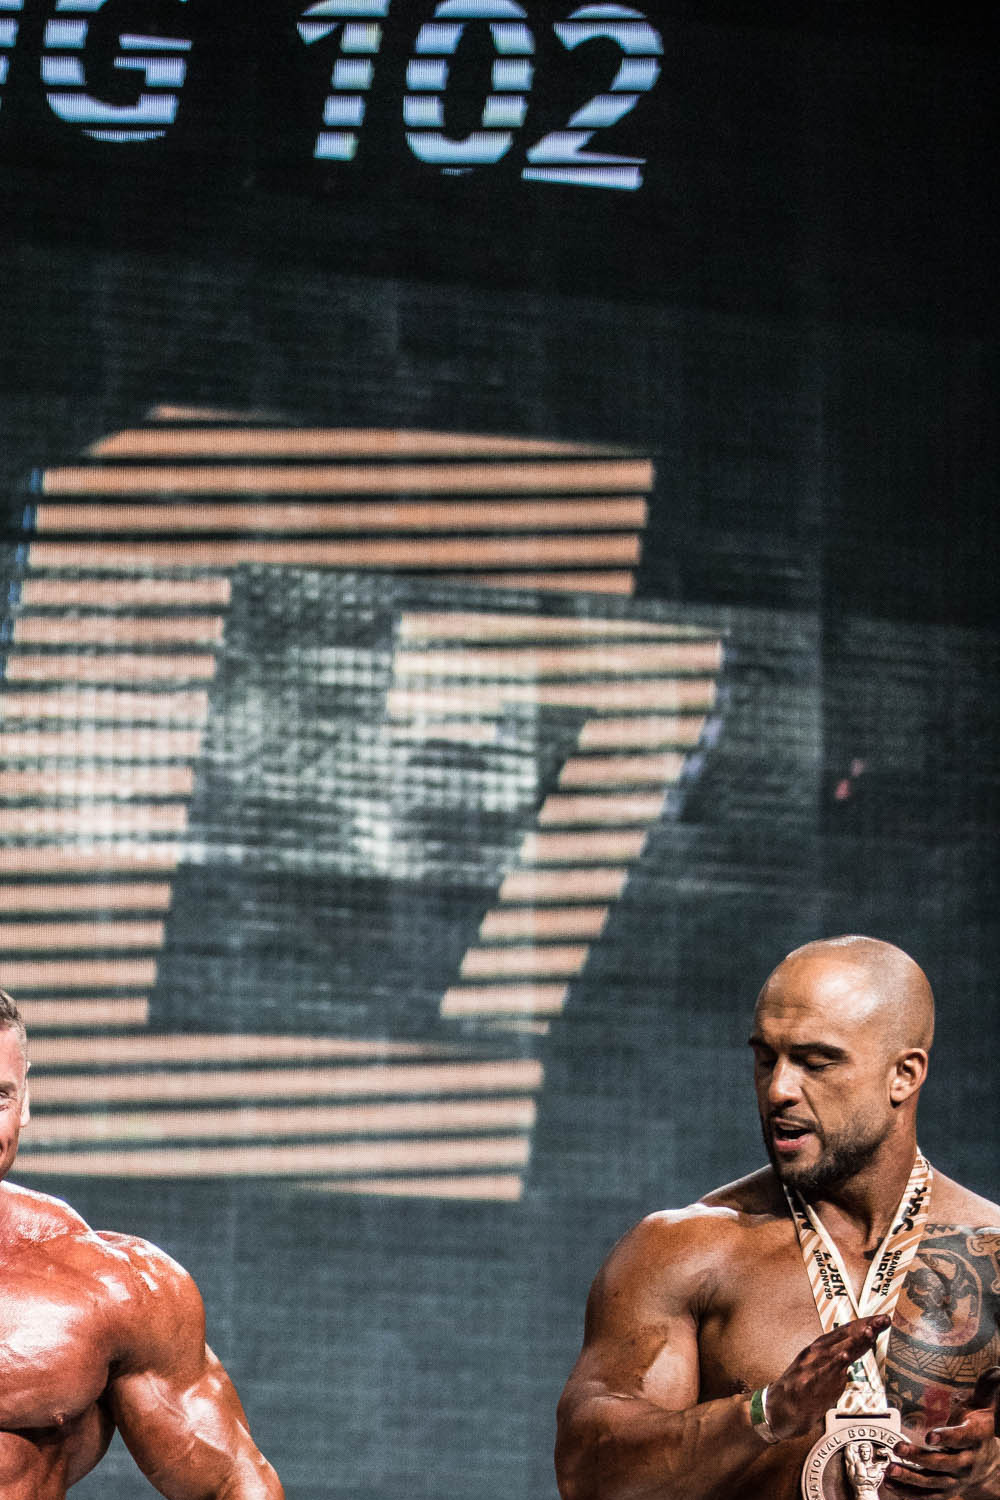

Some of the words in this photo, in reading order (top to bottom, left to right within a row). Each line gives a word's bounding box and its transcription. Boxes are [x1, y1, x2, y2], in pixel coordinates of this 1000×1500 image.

[296, 0, 664, 190] 102
[813, 1250, 825, 1267] PRIX
[875, 1252, 892, 1281] NBC
[888, 1250, 902, 1279] GRAND
[820, 1269, 833, 1299] GRAND
[828, 1263, 847, 1296] NBC
[880, 1279, 892, 1297] PRIX
